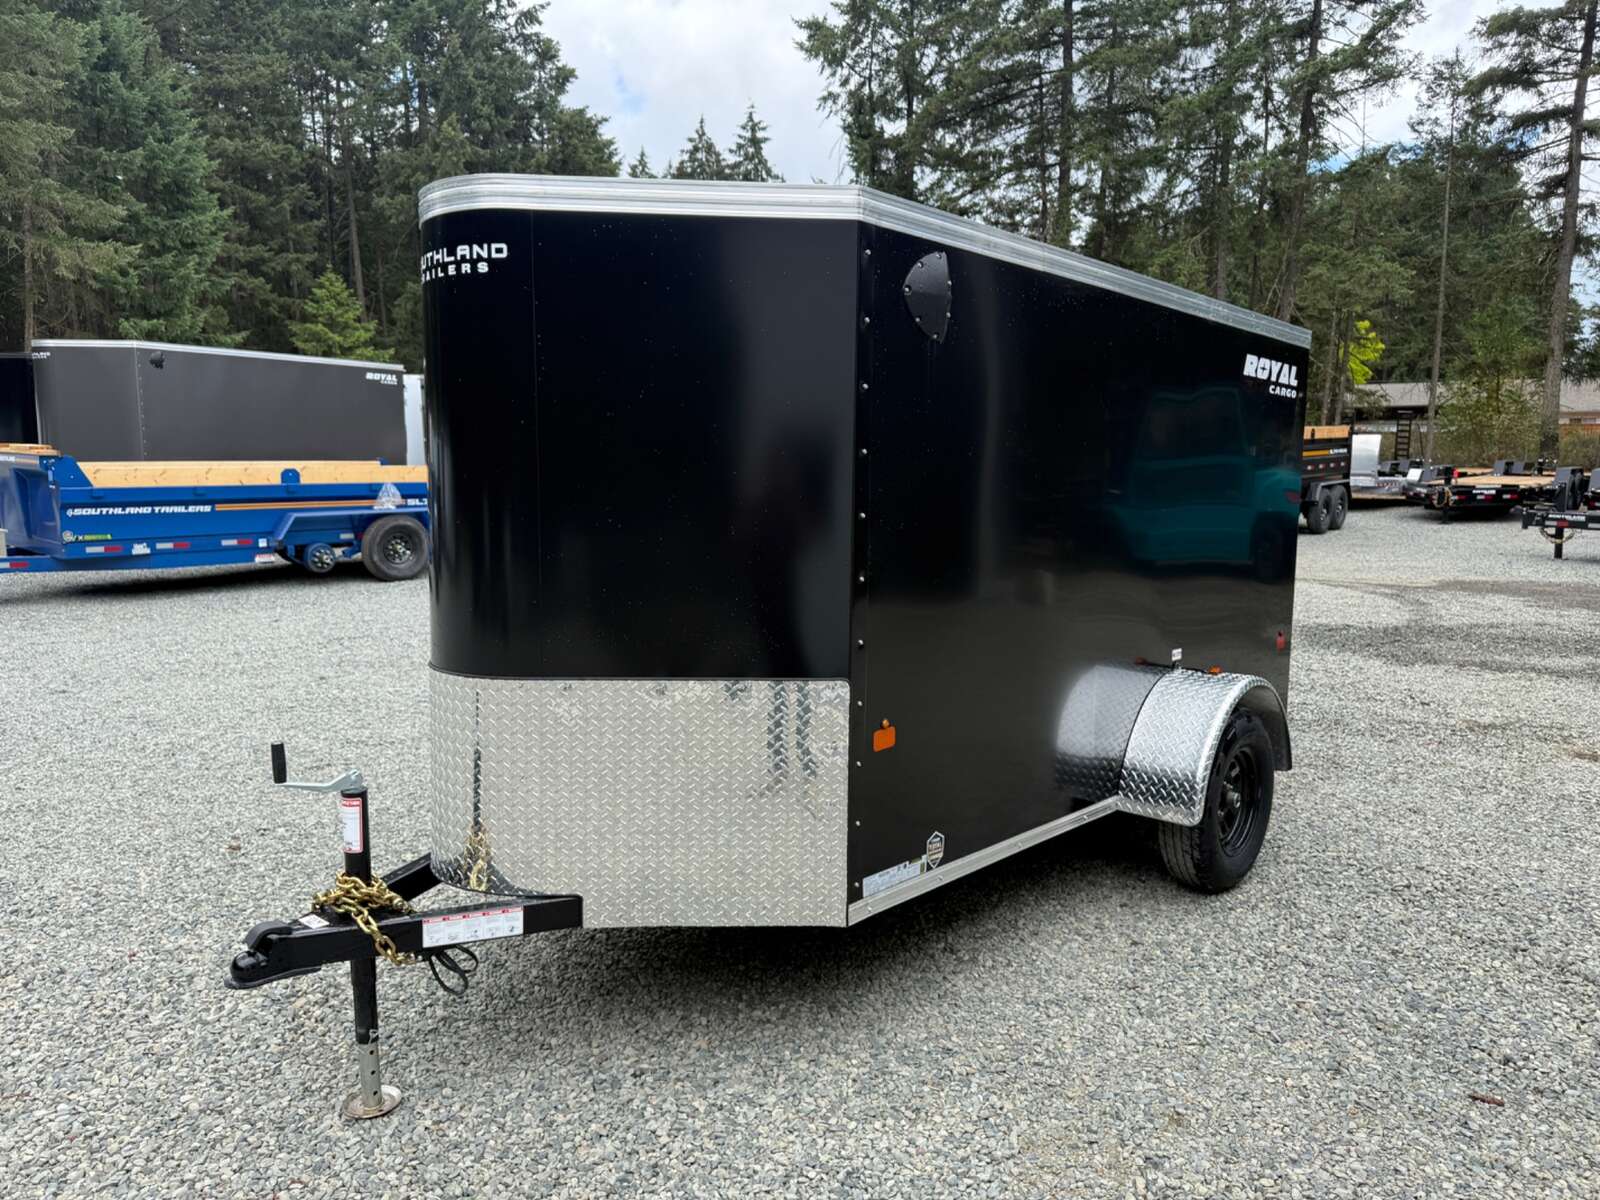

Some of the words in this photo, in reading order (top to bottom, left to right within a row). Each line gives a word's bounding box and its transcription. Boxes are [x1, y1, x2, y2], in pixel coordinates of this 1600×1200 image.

[421, 243, 508, 270] UTHLAND
[366, 371, 398, 381] ROYAL
[1243, 353, 1298, 387] ROYAL
[1269, 384, 1297, 399] CARGO
[73, 507, 151, 517] SOUTHLAND
[153, 505, 212, 514] TRAILERS
